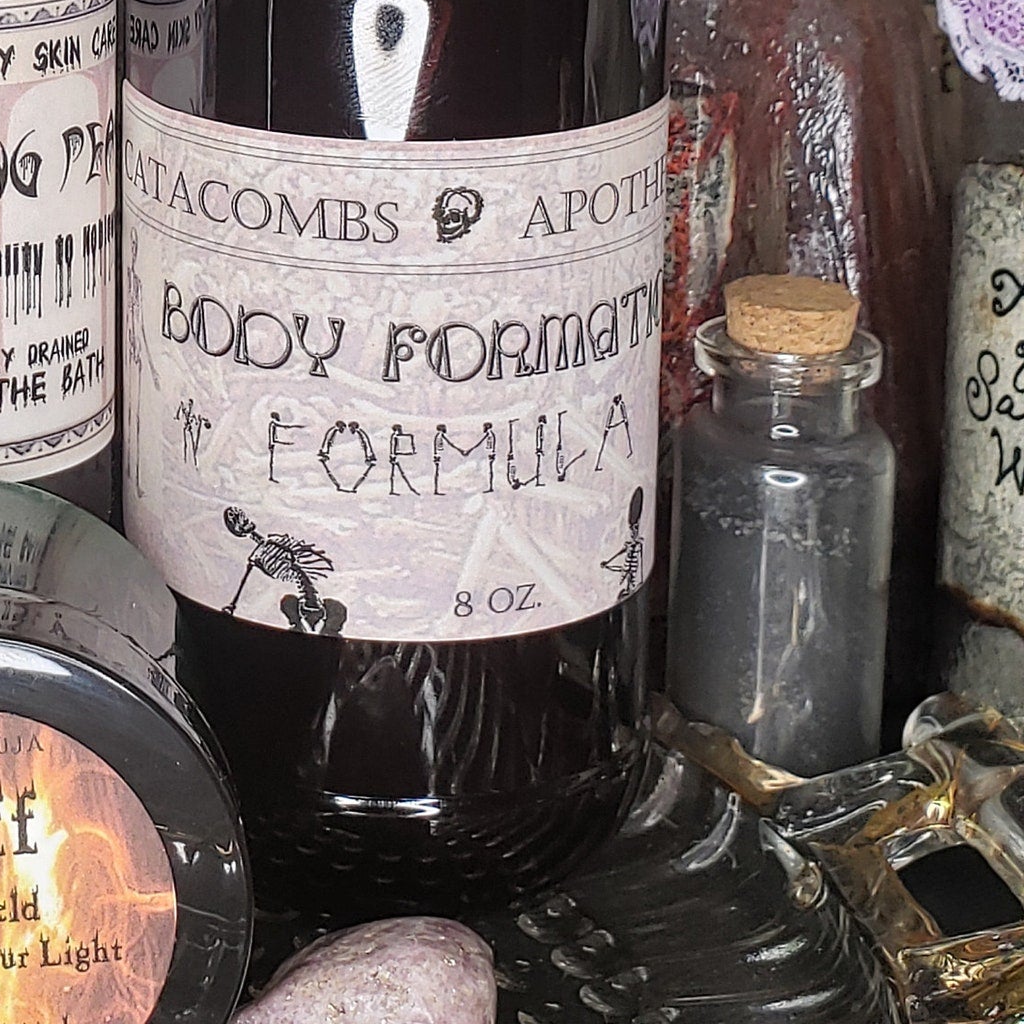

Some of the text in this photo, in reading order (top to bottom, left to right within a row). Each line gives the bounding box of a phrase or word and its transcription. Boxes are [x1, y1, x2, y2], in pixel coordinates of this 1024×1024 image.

[33, 35, 81, 76] SKIN
[125, 139, 400, 244] CATACOMBS
[28, 326, 90, 369] DRAINED
[162, 279, 344, 378] BODY
[61, 345, 106, 399] BATH
[268, 393, 634, 497] FORMULA
[453, 583, 542, 617] 8 OZ.
[39, 929, 124, 974] Light
